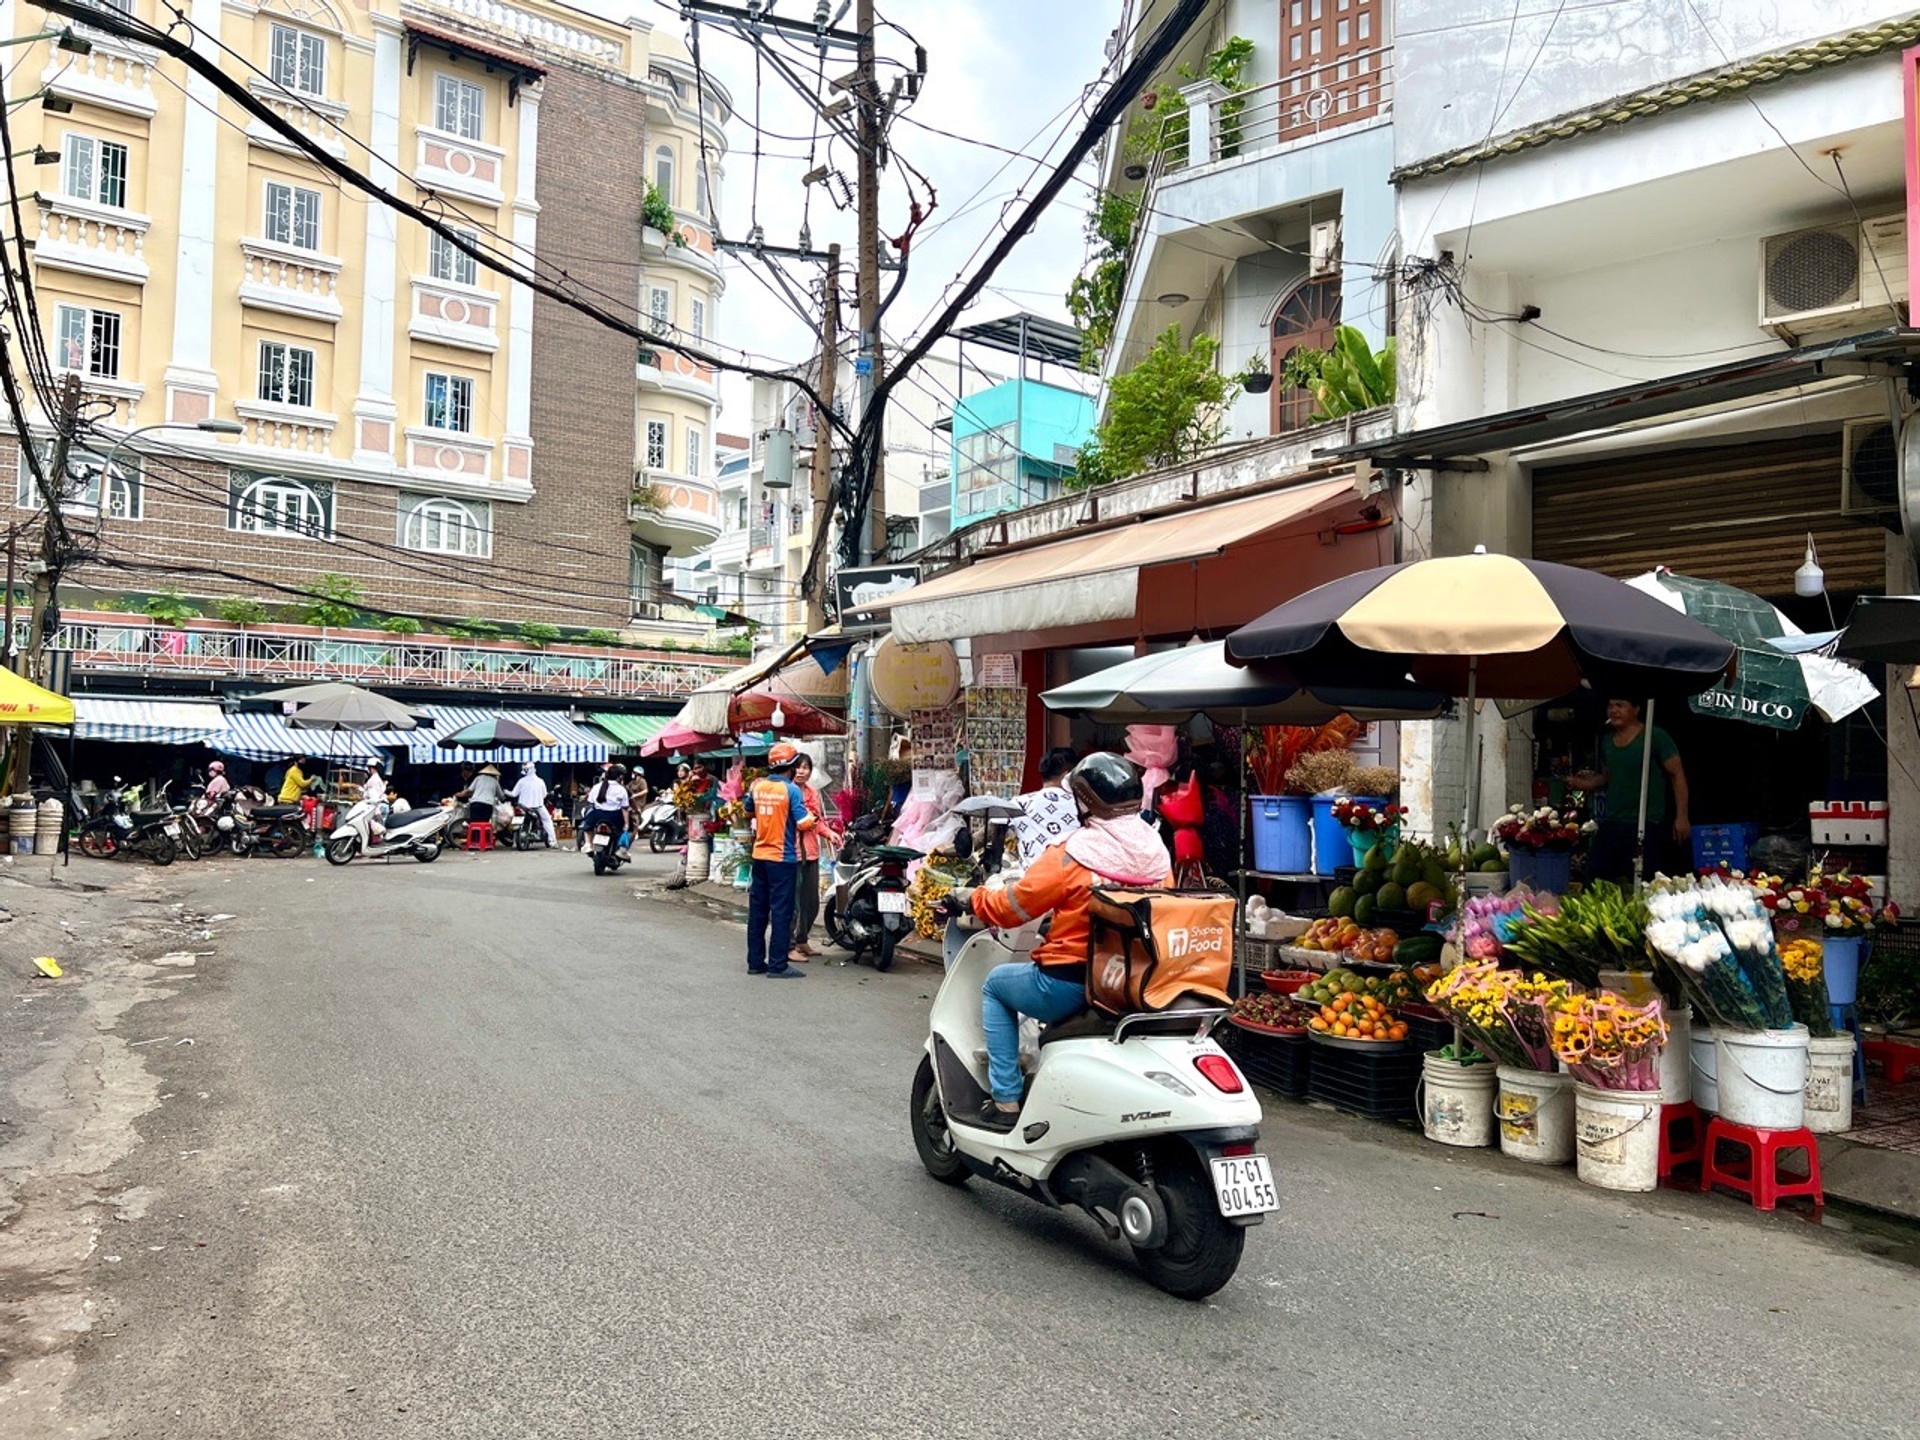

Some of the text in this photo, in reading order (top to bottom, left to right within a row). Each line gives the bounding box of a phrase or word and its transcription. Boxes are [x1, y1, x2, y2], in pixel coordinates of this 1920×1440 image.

[1190, 926, 1224, 938] Shopee
[1188, 936, 1223, 954] Food
[1221, 1183, 1275, 1211] 904.55
